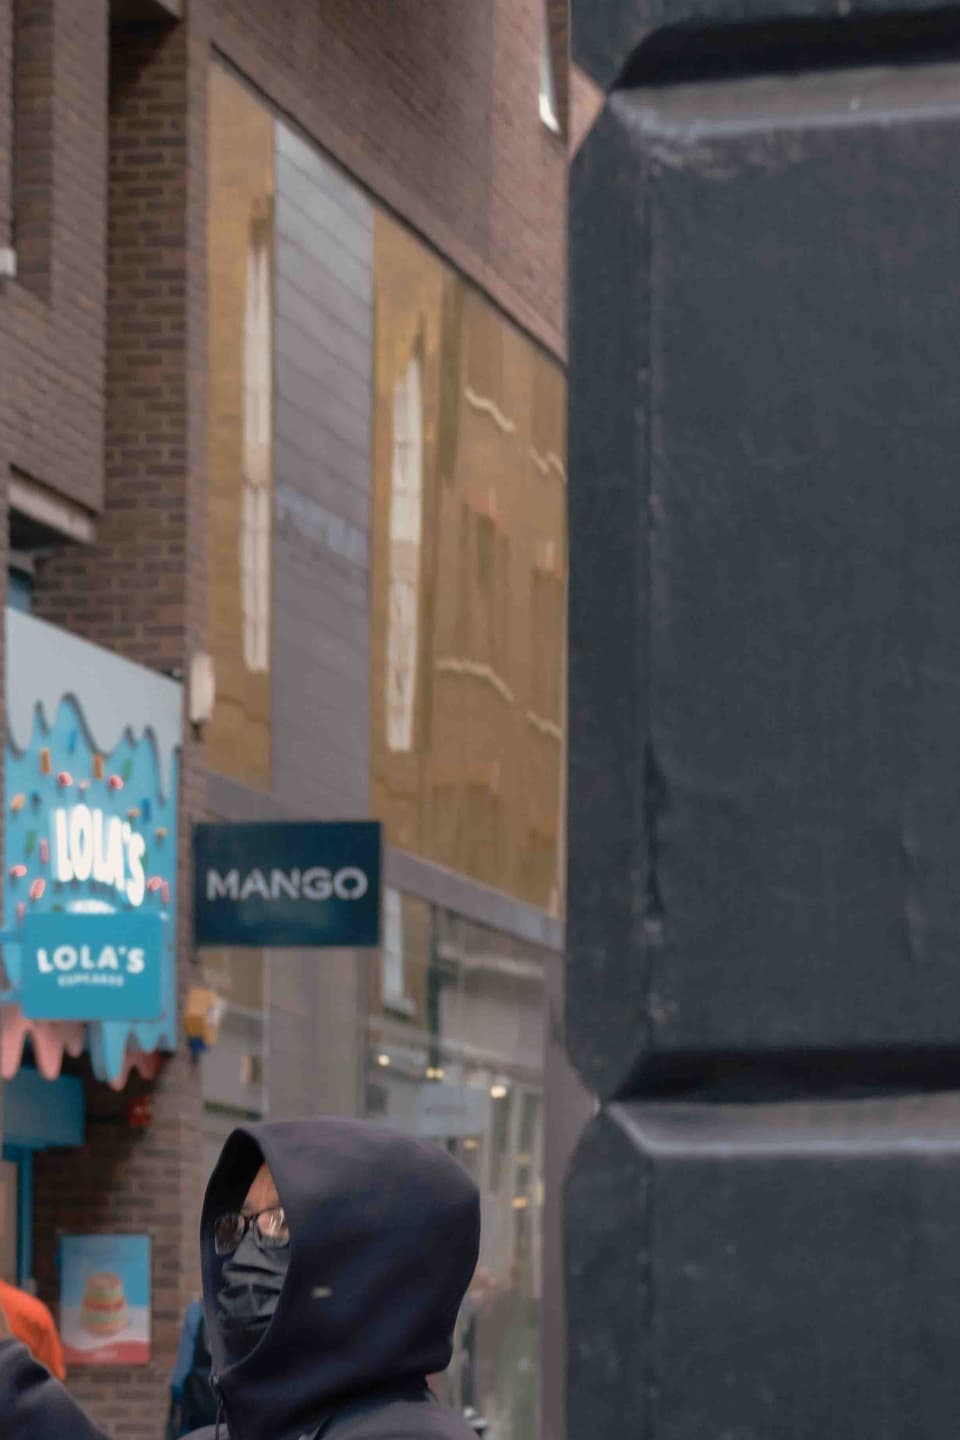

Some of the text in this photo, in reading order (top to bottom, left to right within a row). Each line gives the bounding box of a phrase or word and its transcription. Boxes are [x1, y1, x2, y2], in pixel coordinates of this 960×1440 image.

[55, 803, 146, 907] LOLA'S
[206, 866, 368, 901] MANGO
[37, 945, 145, 974] LOLA'S
